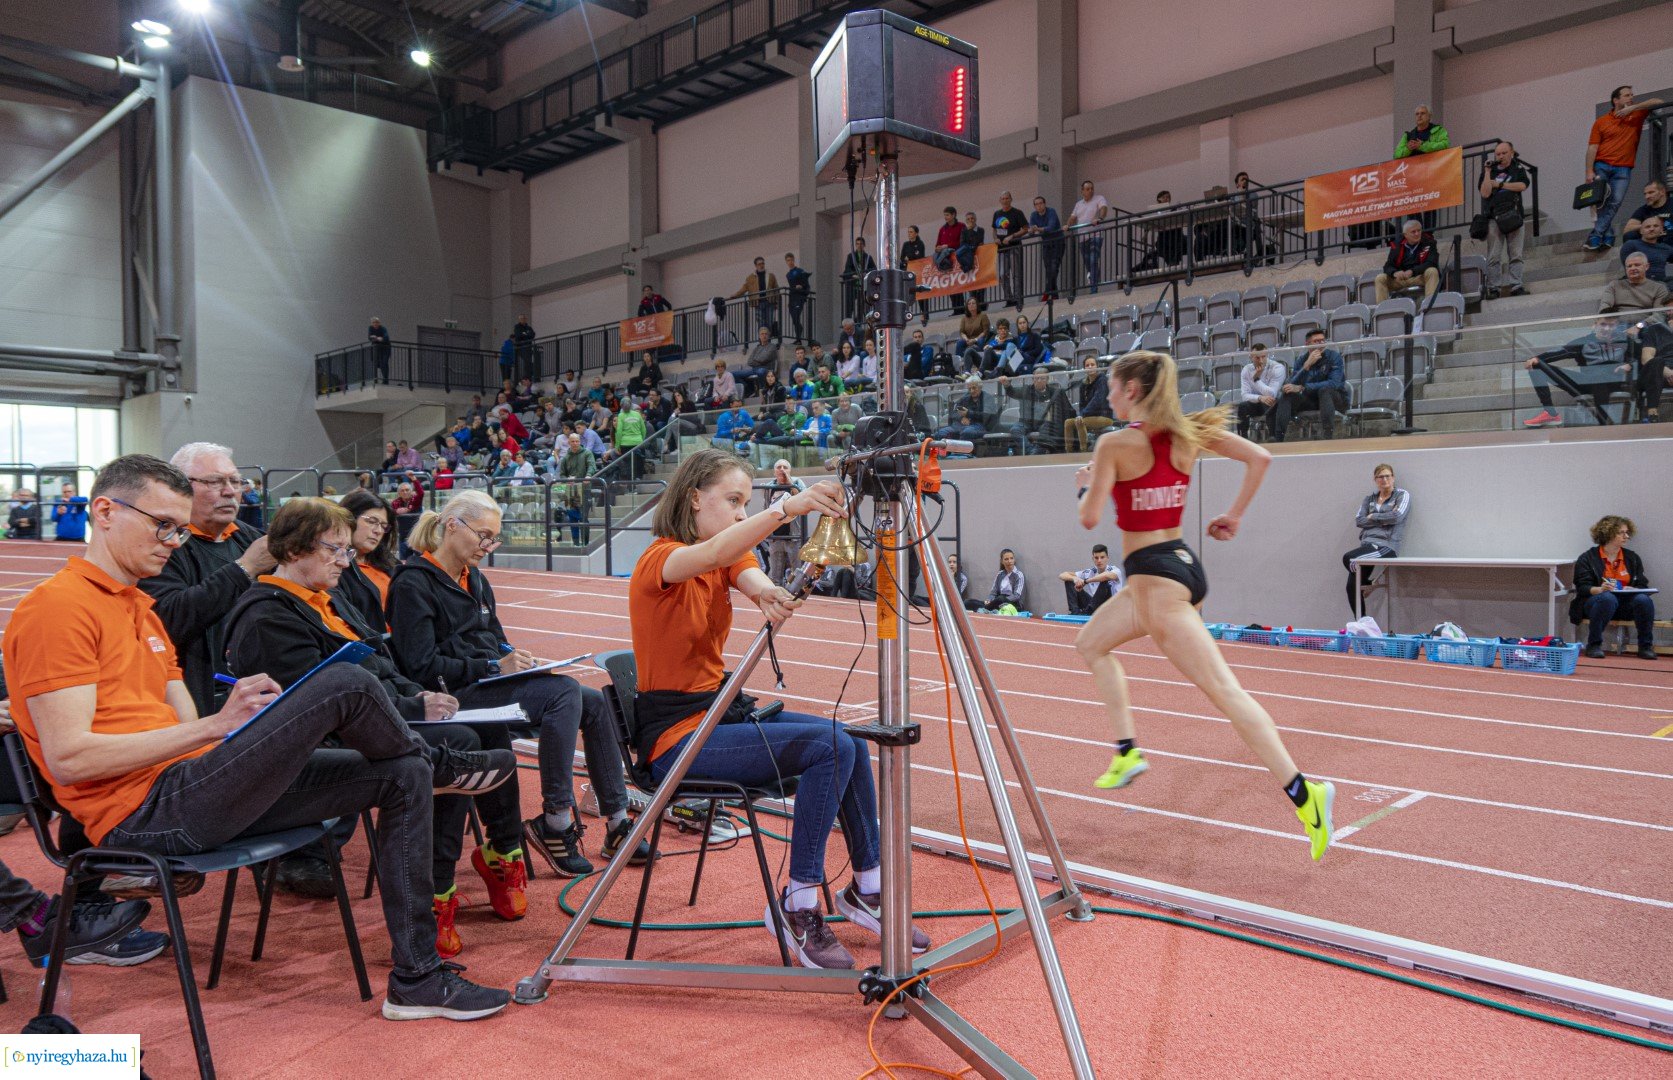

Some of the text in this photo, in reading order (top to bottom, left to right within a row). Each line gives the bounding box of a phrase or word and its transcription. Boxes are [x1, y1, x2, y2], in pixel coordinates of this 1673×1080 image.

[954, 67, 965, 130] 1
[1349, 170, 1380, 193] 125
[1387, 178, 1406, 188] MASZ
[1323, 208, 1354, 219] MAGYAR
[1354, 201, 1393, 214] ATLÉTIKAI
